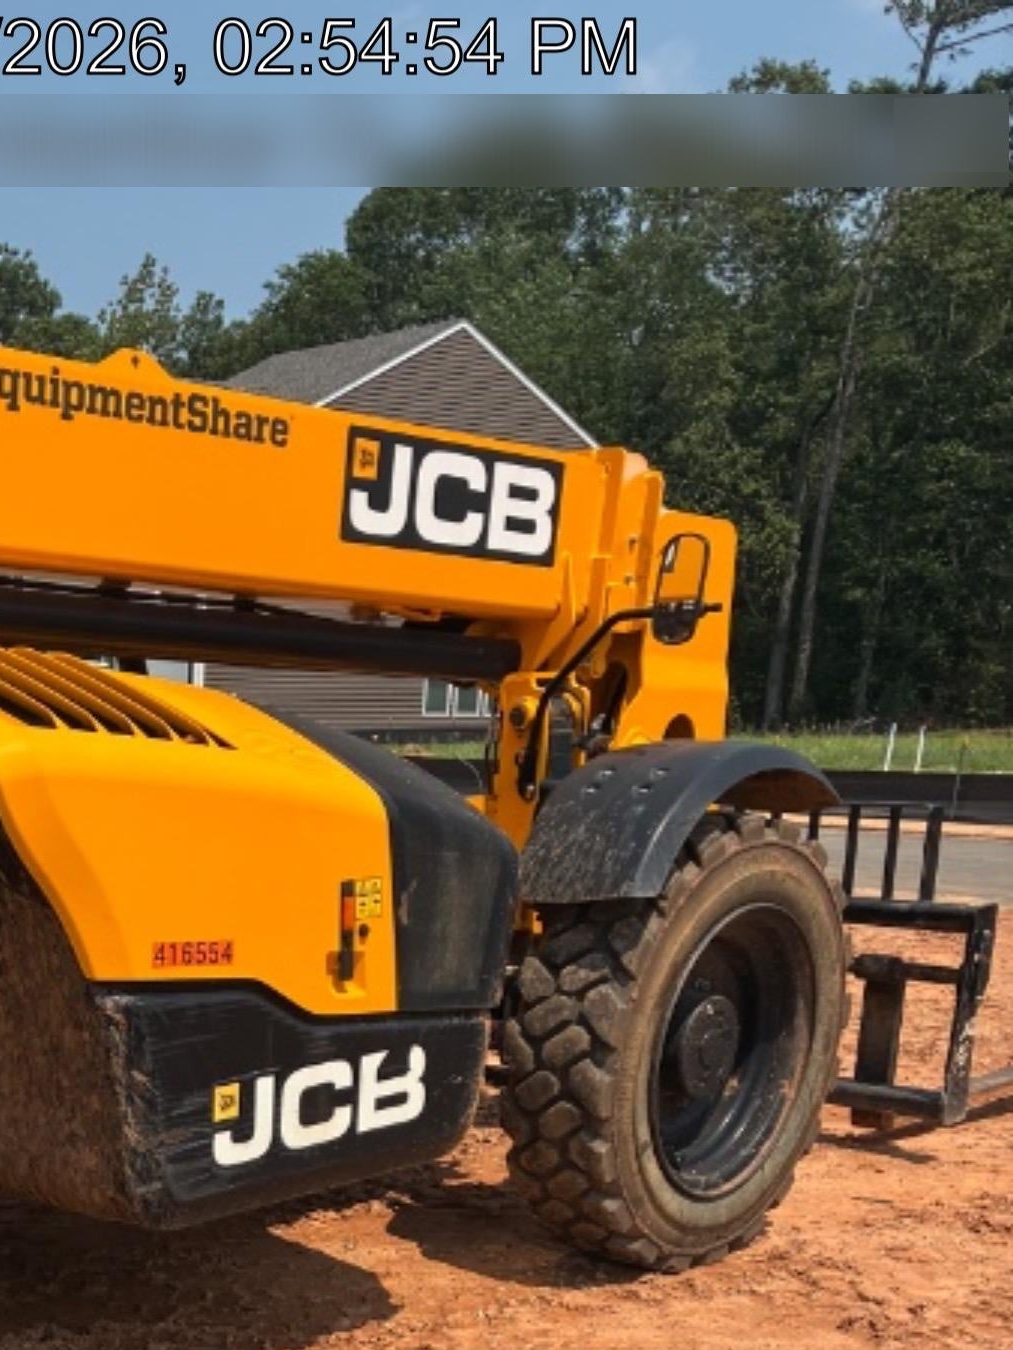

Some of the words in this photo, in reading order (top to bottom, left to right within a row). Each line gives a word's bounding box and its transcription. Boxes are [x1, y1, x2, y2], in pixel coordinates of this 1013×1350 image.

[349, 443, 556, 556] JCB
[155, 940, 233, 967] 416554
[212, 1044, 427, 1167] JCB
